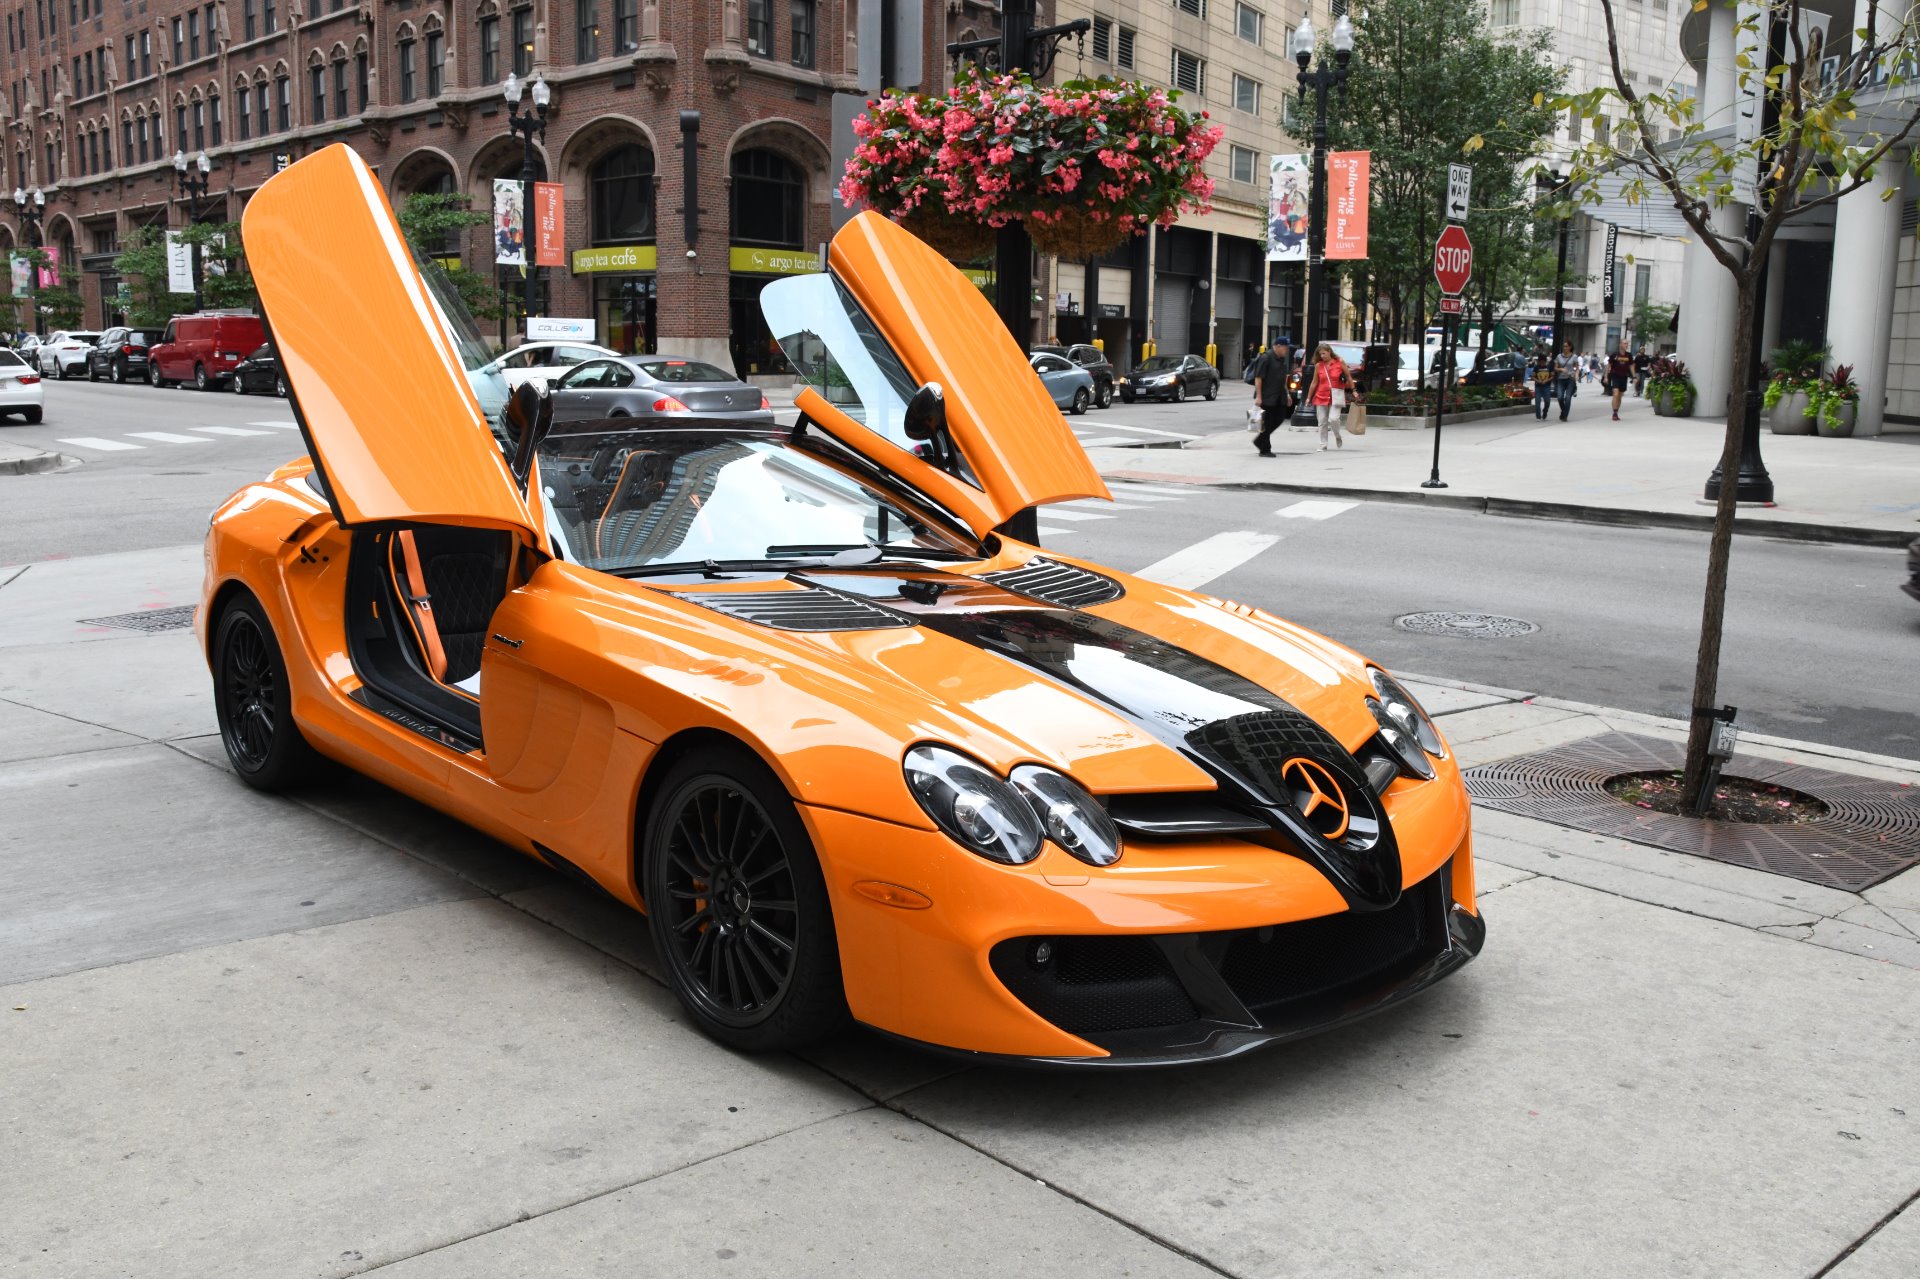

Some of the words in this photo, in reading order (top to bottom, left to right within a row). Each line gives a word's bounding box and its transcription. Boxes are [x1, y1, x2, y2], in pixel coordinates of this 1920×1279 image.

[1451, 169, 1469, 184] ONE
[1346, 159, 1358, 215] Following
[1451, 183, 1468, 199] WAY
[548, 188, 556, 231] Following
[1338, 197, 1347, 215] the
[1337, 218, 1346, 239] Box
[595, 254, 608, 266] tea
[611, 248, 637, 265] café
[1605, 224, 1615, 273] ORDSTROM
[770, 256, 792, 271] argo
[794, 257, 805, 270] tea
[1437, 246, 1470, 273] STOP
[1604, 275, 1613, 298] rack
[1442, 301, 1450, 310] ALL
[1450, 301, 1459, 311] WAY
